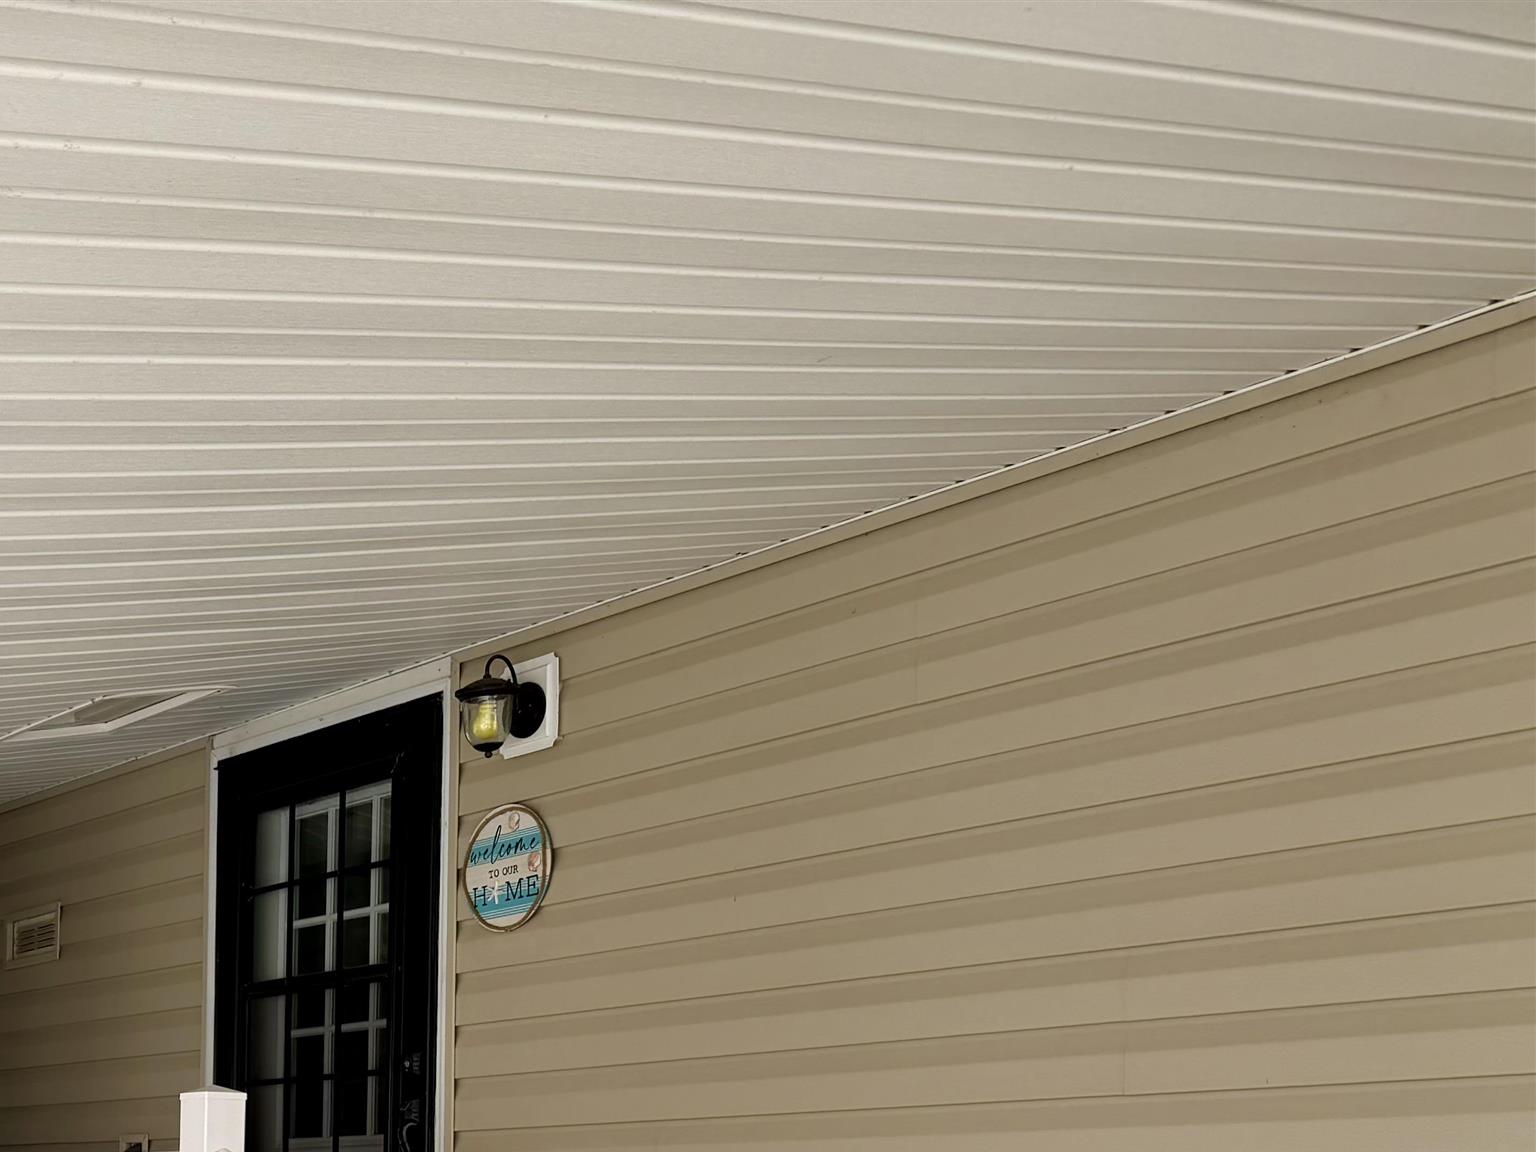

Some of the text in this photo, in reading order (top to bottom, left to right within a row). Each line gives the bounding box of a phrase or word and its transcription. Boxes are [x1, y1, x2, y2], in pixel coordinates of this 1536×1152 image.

[470, 824, 540, 865] welcome
[488, 864, 519, 879] TO OUR
[472, 873, 540, 909] HME
